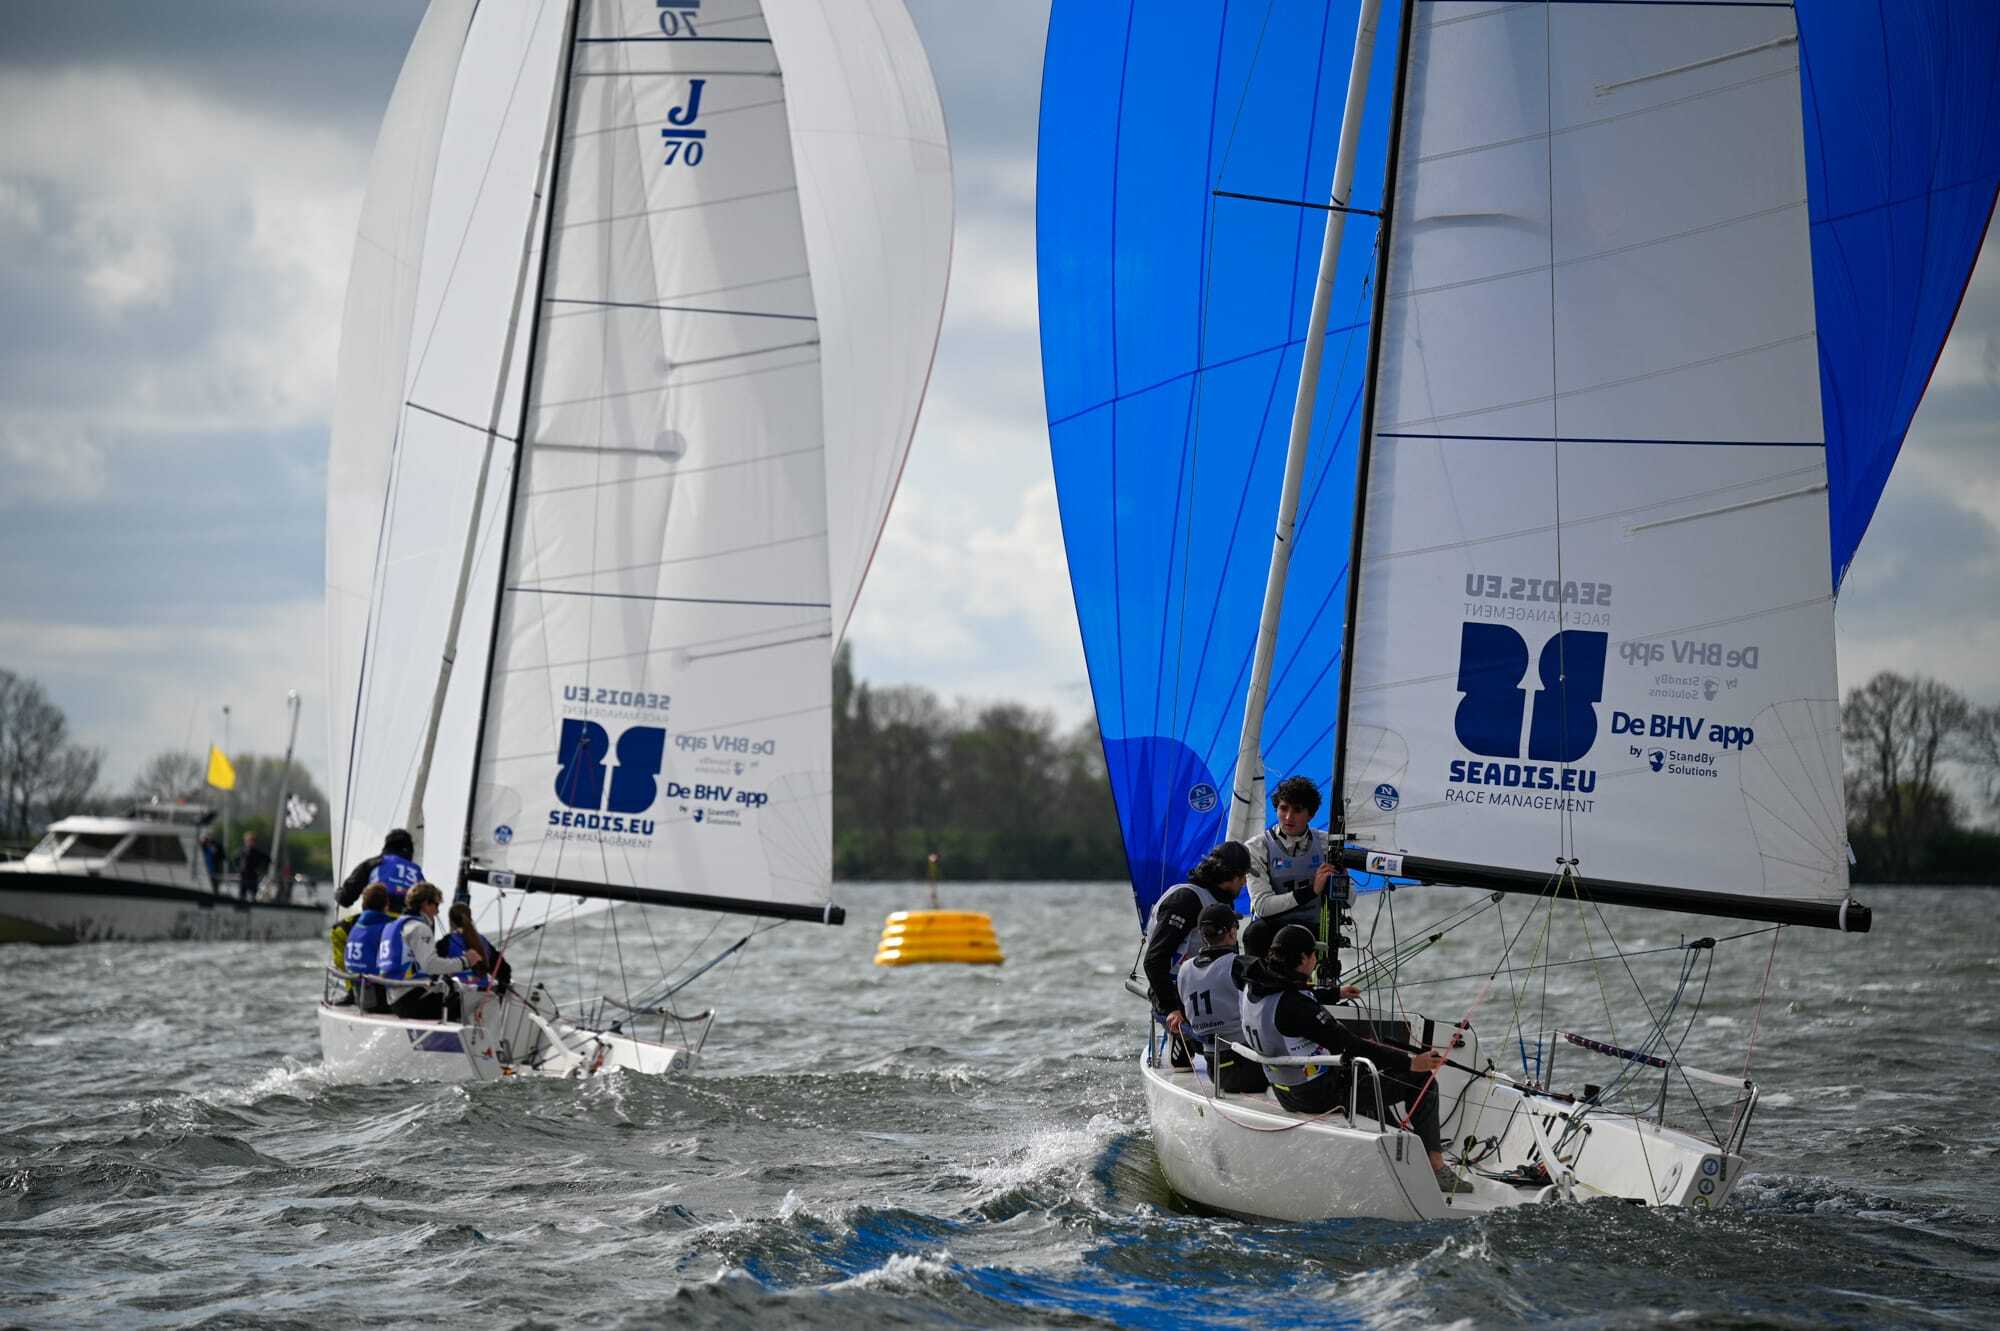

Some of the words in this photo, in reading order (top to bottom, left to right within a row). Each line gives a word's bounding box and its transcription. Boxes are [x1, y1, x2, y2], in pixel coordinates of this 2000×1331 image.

[668, 79, 706, 125] J
[664, 140, 703, 166] 70
[1612, 712, 1645, 736] De
[1650, 714, 1705, 740] BHV
[1708, 723, 1754, 751] app
[1630, 745, 1642, 758] by
[1669, 750, 1715, 765] StandBy
[1449, 760, 1596, 793] SEADIS.EU
[1668, 764, 1718, 778] Solutions
[667, 782, 690, 799] De
[694, 784, 733, 801] BHV
[736, 791, 768, 808] app
[1446, 788, 1485, 804] RACE
[1489, 793, 1596, 813] MANAGEMENT
[549, 810, 654, 835] SEADIS.EU
[396, 864, 417, 881] 13
[347, 940, 363, 960] 13
[1189, 990, 1213, 1016] 11
